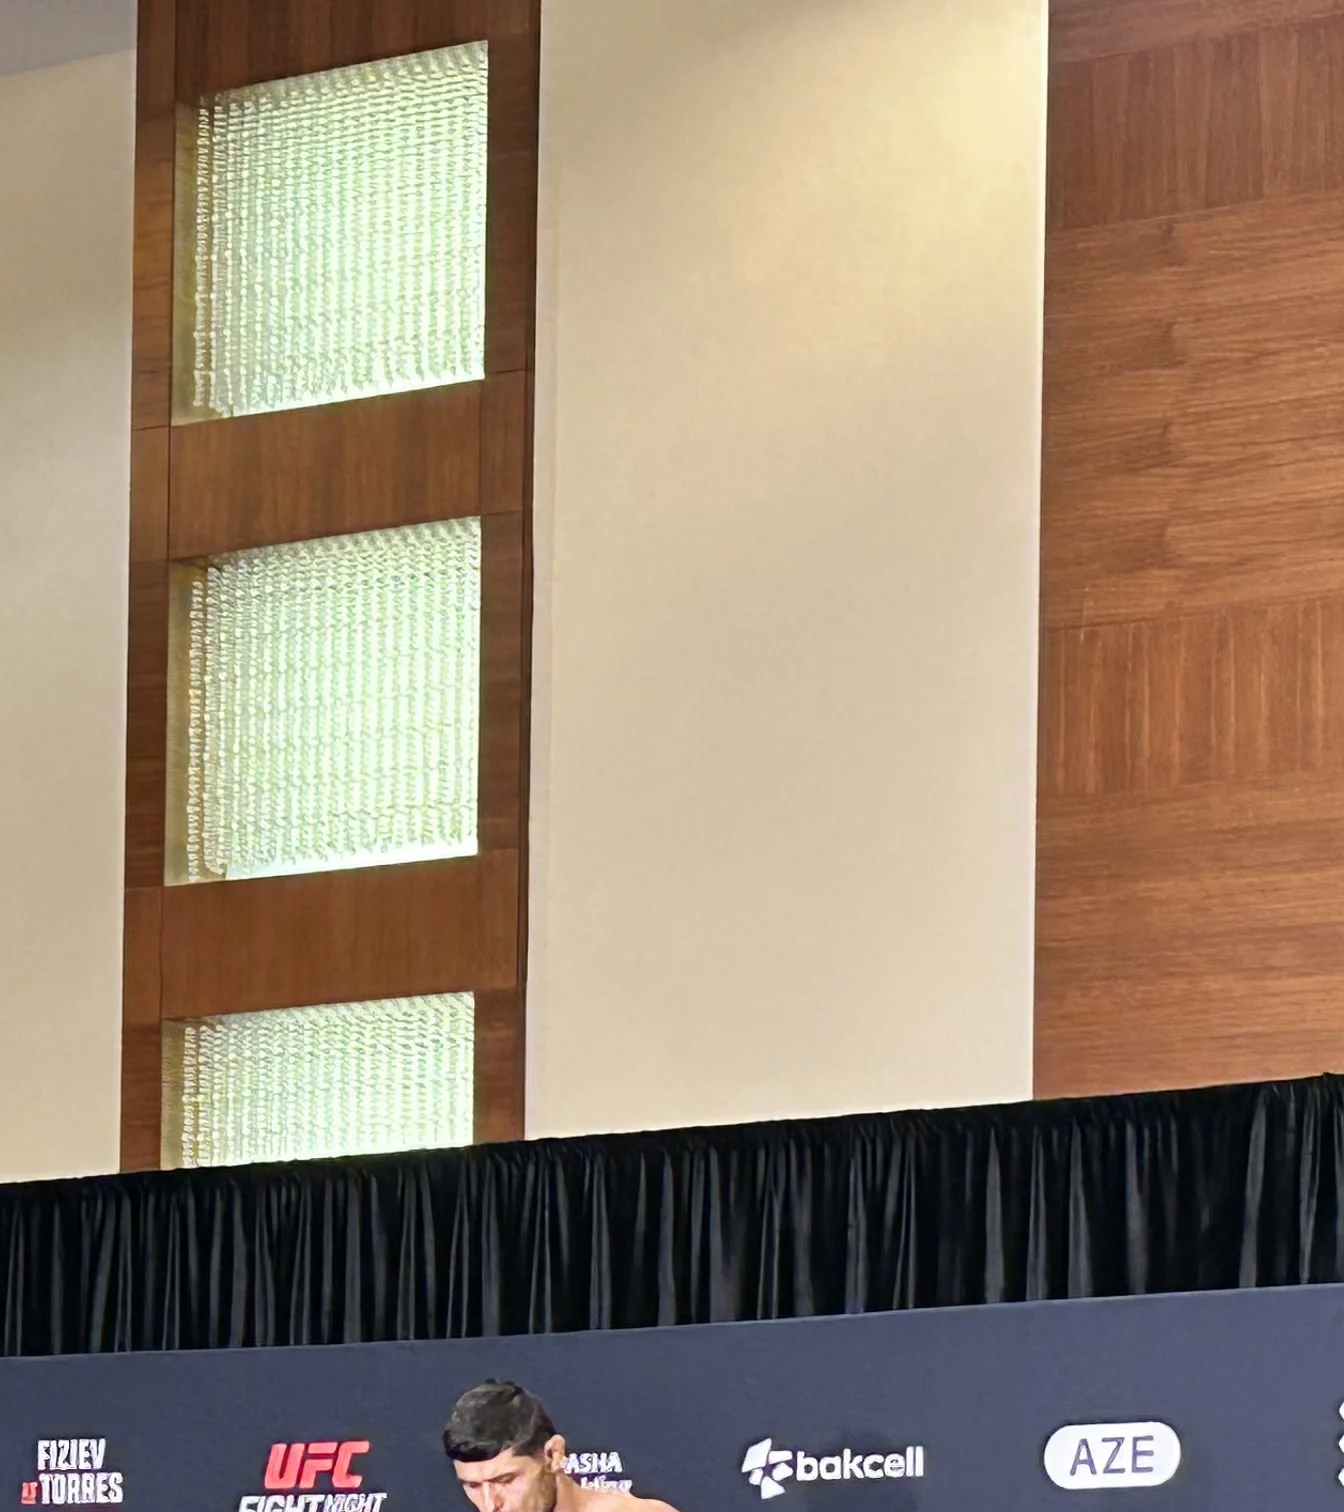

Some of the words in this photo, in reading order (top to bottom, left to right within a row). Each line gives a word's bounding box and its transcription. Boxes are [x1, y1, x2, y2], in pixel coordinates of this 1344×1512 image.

[38, 1438, 106, 1470] FIZIEV
[264, 1440, 370, 1489] UFC
[560, 1452, 623, 1474] ASHA
[797, 1446, 924, 1482] bakcell
[1069, 1437, 1155, 1475] AZE
[39, 1472, 123, 1504] TORRES
